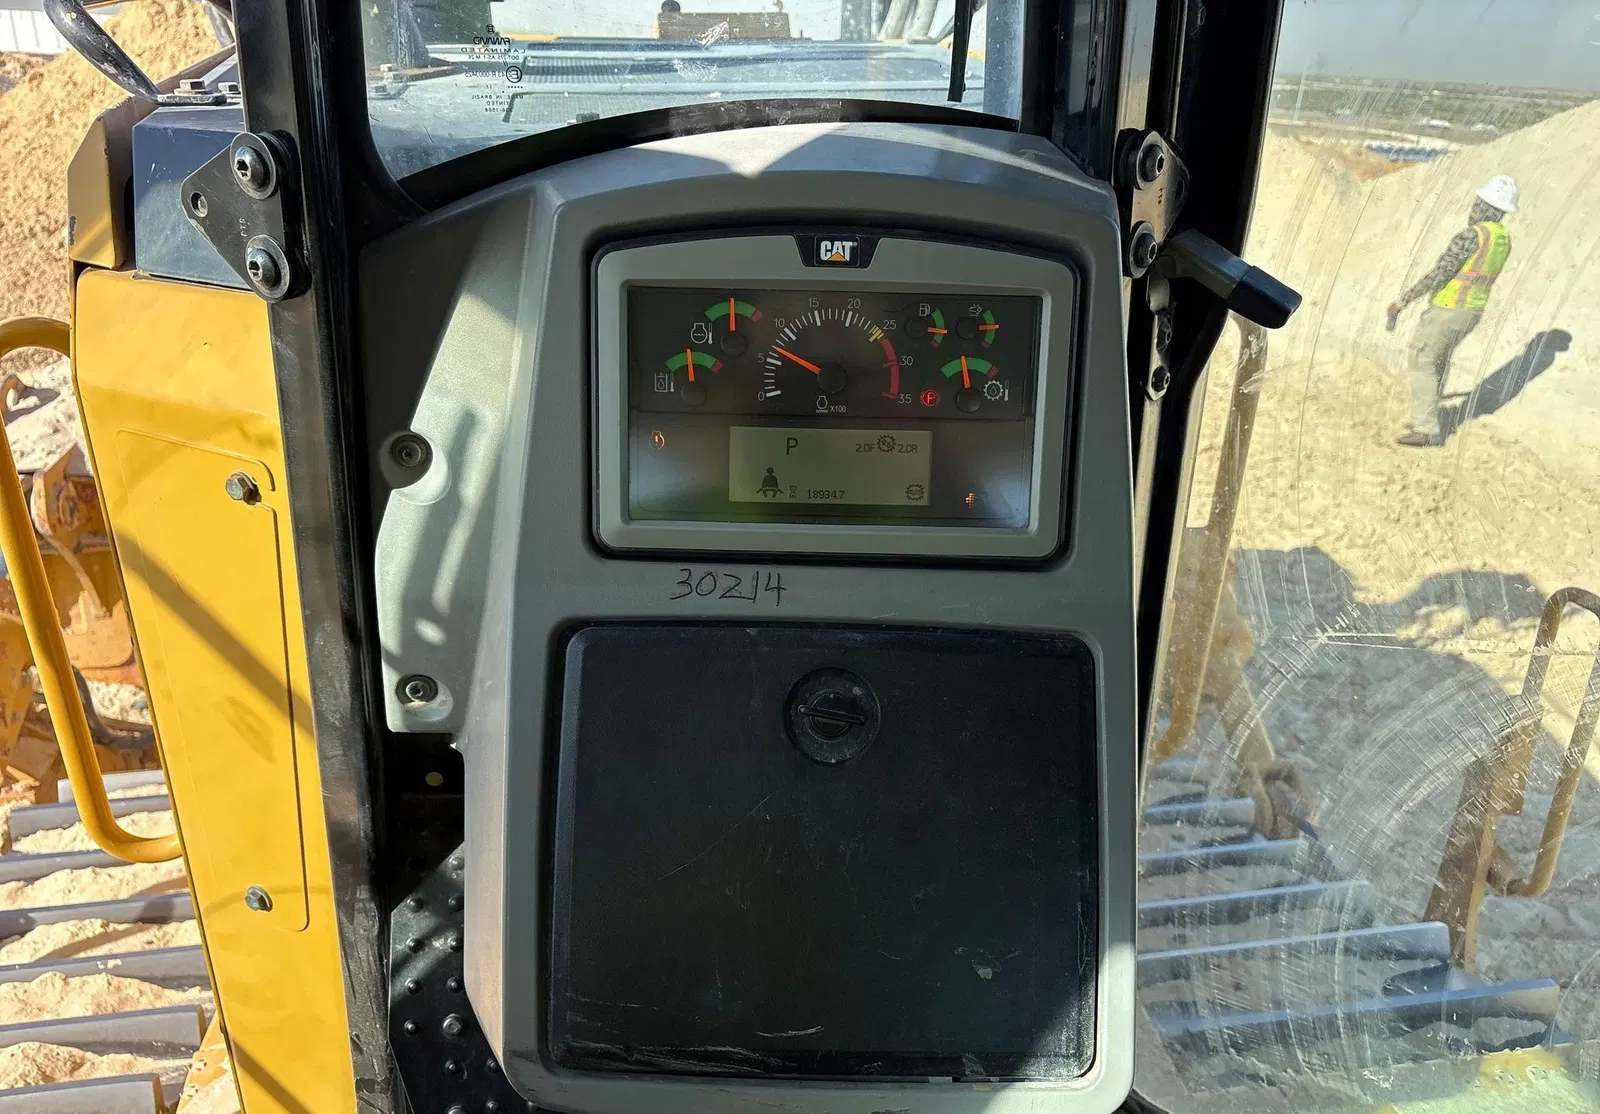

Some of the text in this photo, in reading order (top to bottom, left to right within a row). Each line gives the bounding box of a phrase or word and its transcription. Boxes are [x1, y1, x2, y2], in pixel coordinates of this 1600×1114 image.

[820, 240, 853, 261] CAT
[808, 298, 820, 308] 15
[847, 299, 861, 309] 20
[774, 318, 785, 328] 10
[883, 319, 897, 330] 25
[758, 353, 765, 363] 5
[900, 356, 914, 366] 30
[757, 392, 765, 401] 0
[898, 394, 912, 404] 35
[829, 405, 847, 413] X100
[786, 437, 799, 455] P
[807, 489, 845, 500] 18934.7
